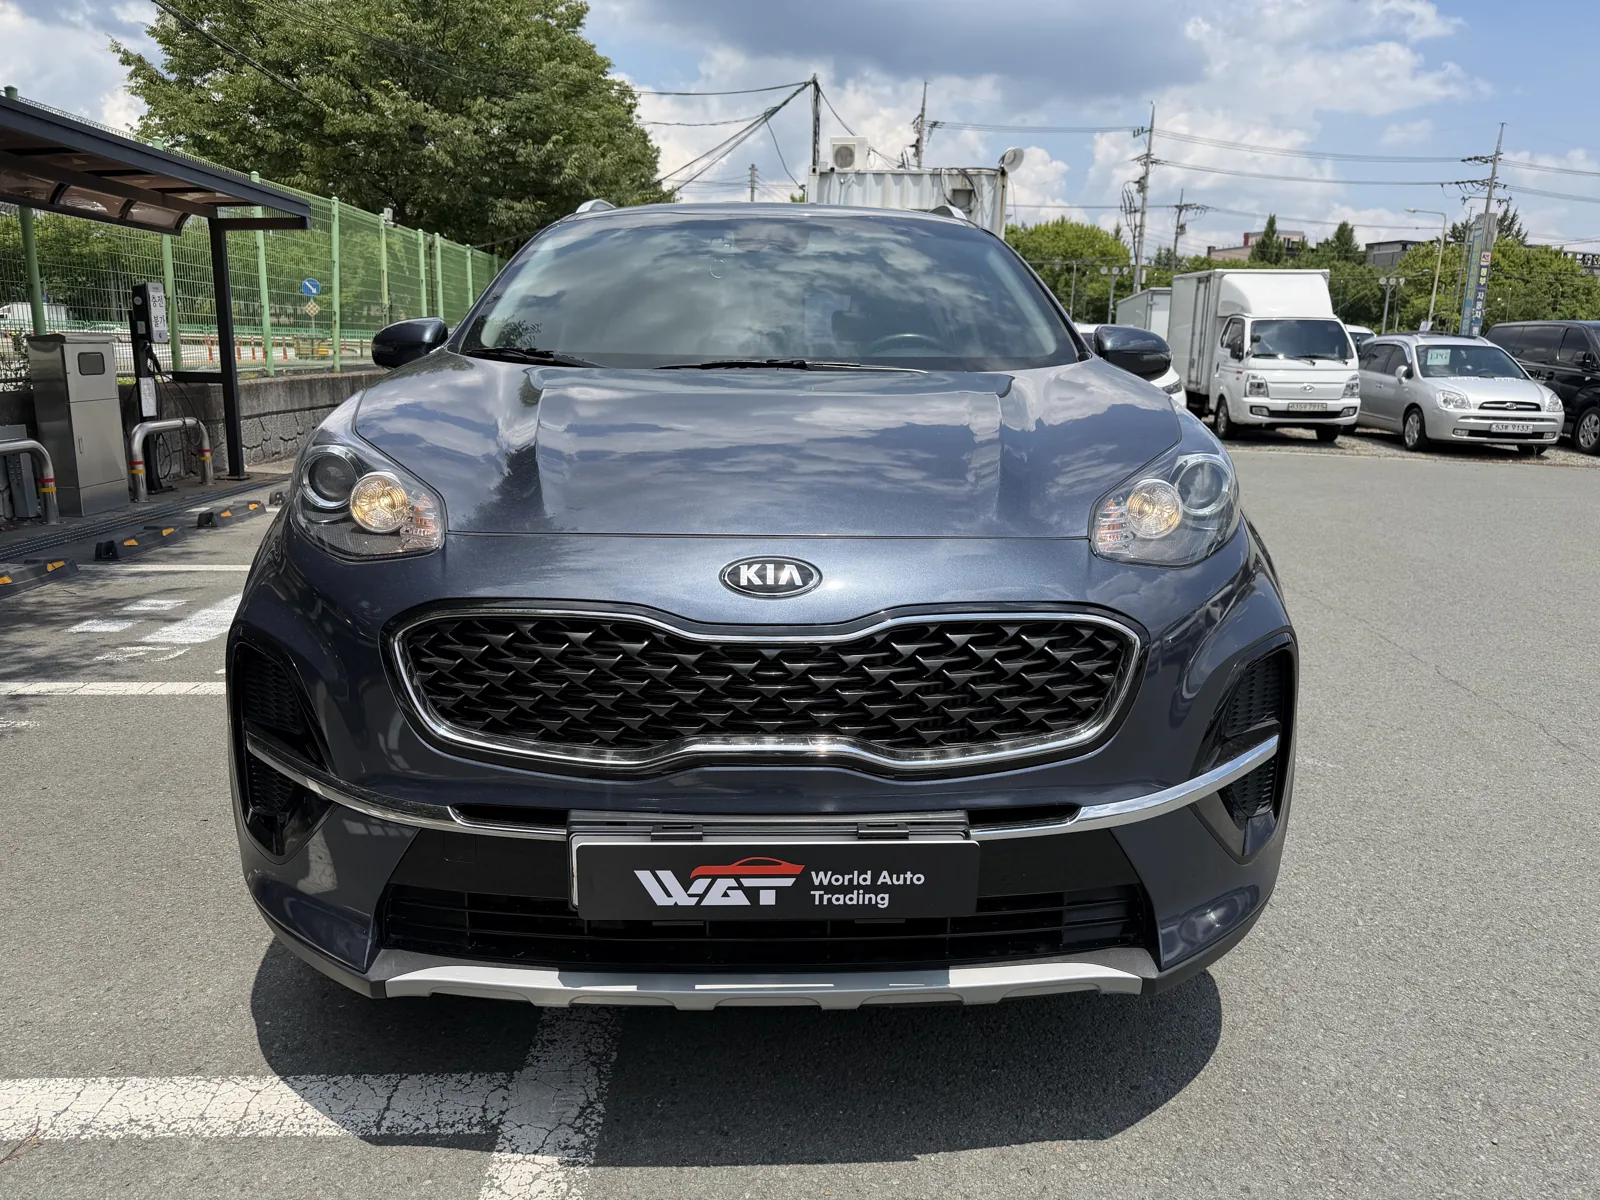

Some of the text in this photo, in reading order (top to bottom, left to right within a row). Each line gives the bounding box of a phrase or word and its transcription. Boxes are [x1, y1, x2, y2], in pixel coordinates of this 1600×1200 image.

[739, 563, 803, 586] KIA
[633, 869, 797, 906] WAT
[810, 870, 925, 886] World Auto
[810, 890, 890, 909] Trading
